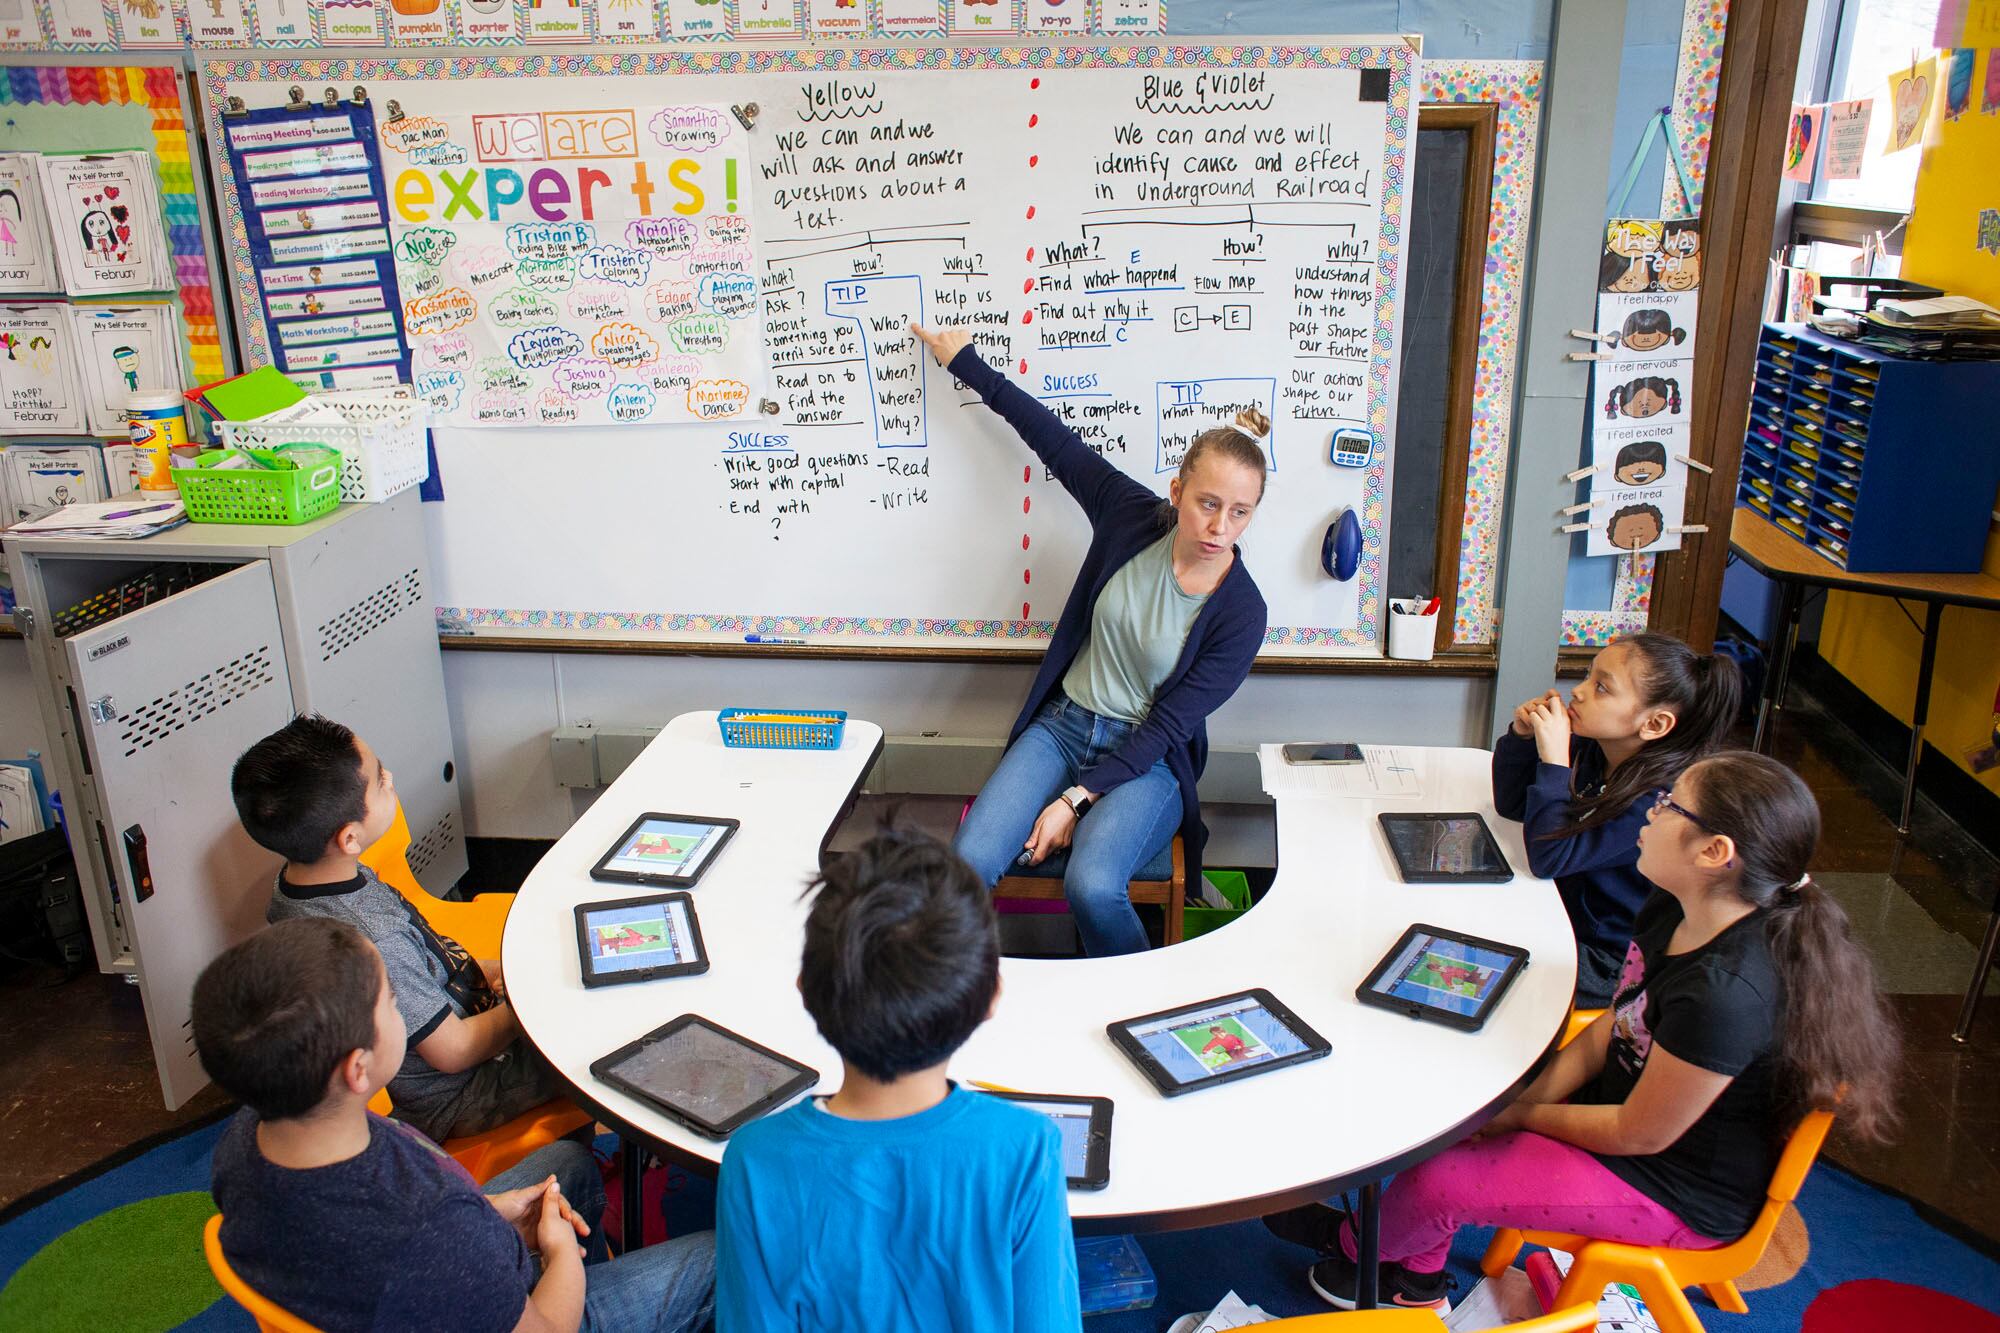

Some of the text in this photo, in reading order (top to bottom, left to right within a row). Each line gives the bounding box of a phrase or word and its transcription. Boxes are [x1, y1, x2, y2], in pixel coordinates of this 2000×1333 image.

[535, 21, 578, 32] rainbow
[618, 22, 635, 30] sun
[683, 20, 713, 31] turtle
[743, 17, 791, 29] umbrella
[817, 17, 861, 27] vacuum
[885, 16, 937, 24] watermelon
[974, 14, 992, 25] fox
[1040, 16, 1072, 27] yo-yo
[1114, 14, 1147, 25] zebra
[72, 27, 92, 38] kite
[140, 26, 159, 37] lion
[202, 26, 234, 36] mouse
[277, 24, 294, 34] nail
[332, 22, 372, 35] octopus
[399, 22, 442, 35] pumpkin
[469, 22, 509, 34] quarter
[1144, 74, 1183, 98] Blue
[801, 81, 875, 111] Yellow
[232, 130, 272, 143] Morning
[274, 128, 311, 140] Meeting
[552, 116, 632, 154] are
[822, 129, 857, 145] can
[871, 119, 905, 140] and
[1157, 128, 1192, 144] can
[1204, 124, 1245, 144] and
[1294, 123, 1331, 145] will
[761, 150, 963, 180] will ask and answer
[1096, 153, 1169, 180] identify
[1255, 152, 1281, 172] and
[1295, 148, 1359, 170] effect
[1096, 184, 1113, 199] in
[1277, 170, 1369, 198] Railroad
[289, 186, 328, 198] Workshop
[774, 177, 946, 209] questions about
[265, 219, 289, 228] Lunch
[636, 223, 686, 237] Natalie
[514, 229, 567, 244] Tristan
[1665, 229, 1696, 251] Way
[274, 244, 323, 255] Enrichment
[1223, 234, 1263, 255] How?
[590, 254, 635, 268] Tristen
[852, 253, 883, 272] How?
[95, 270, 136, 280] February
[264, 274, 303, 284] Flex Time
[471, 262, 513, 285] Minecraft
[712, 280, 752, 293] Athena
[1228, 276, 1255, 294] map
[832, 286, 866, 300] TIP
[1294, 285, 1372, 303] how things
[1624, 295, 1644, 304] feel
[270, 302, 293, 310] Math
[659, 303, 692, 317] Baking
[766, 299, 790, 314] Ask
[767, 318, 807, 332] about
[870, 314, 907, 332] Who?
[282, 326, 349, 338] Math Workshop
[765, 326, 827, 347] something
[604, 333, 636, 348] Nico
[1327, 340, 1368, 358] future
[287, 355, 318, 363] Science
[875, 364, 916, 382] When?
[1614, 362, 1634, 372] feel
[564, 369, 606, 381] Joshua
[776, 372, 835, 388] Read on
[1323, 371, 1363, 386] actions
[653, 376, 690, 390] Baking
[820, 391, 845, 405] the
[1171, 384, 1202, 402] TIP
[14, 411, 59, 422] February
[703, 403, 735, 416] Dance
[1084, 402, 1142, 424] complete
[797, 410, 843, 424] answer
[1614, 430, 1633, 439] feel
[768, 455, 799, 472] good
[808, 454, 869, 474] questions
[769, 477, 793, 490] with
[802, 474, 844, 492] capital
[1617, 491, 1636, 500] feel
[731, 500, 809, 513] End with
[99, 636, 128, 655] BLACK BOX
